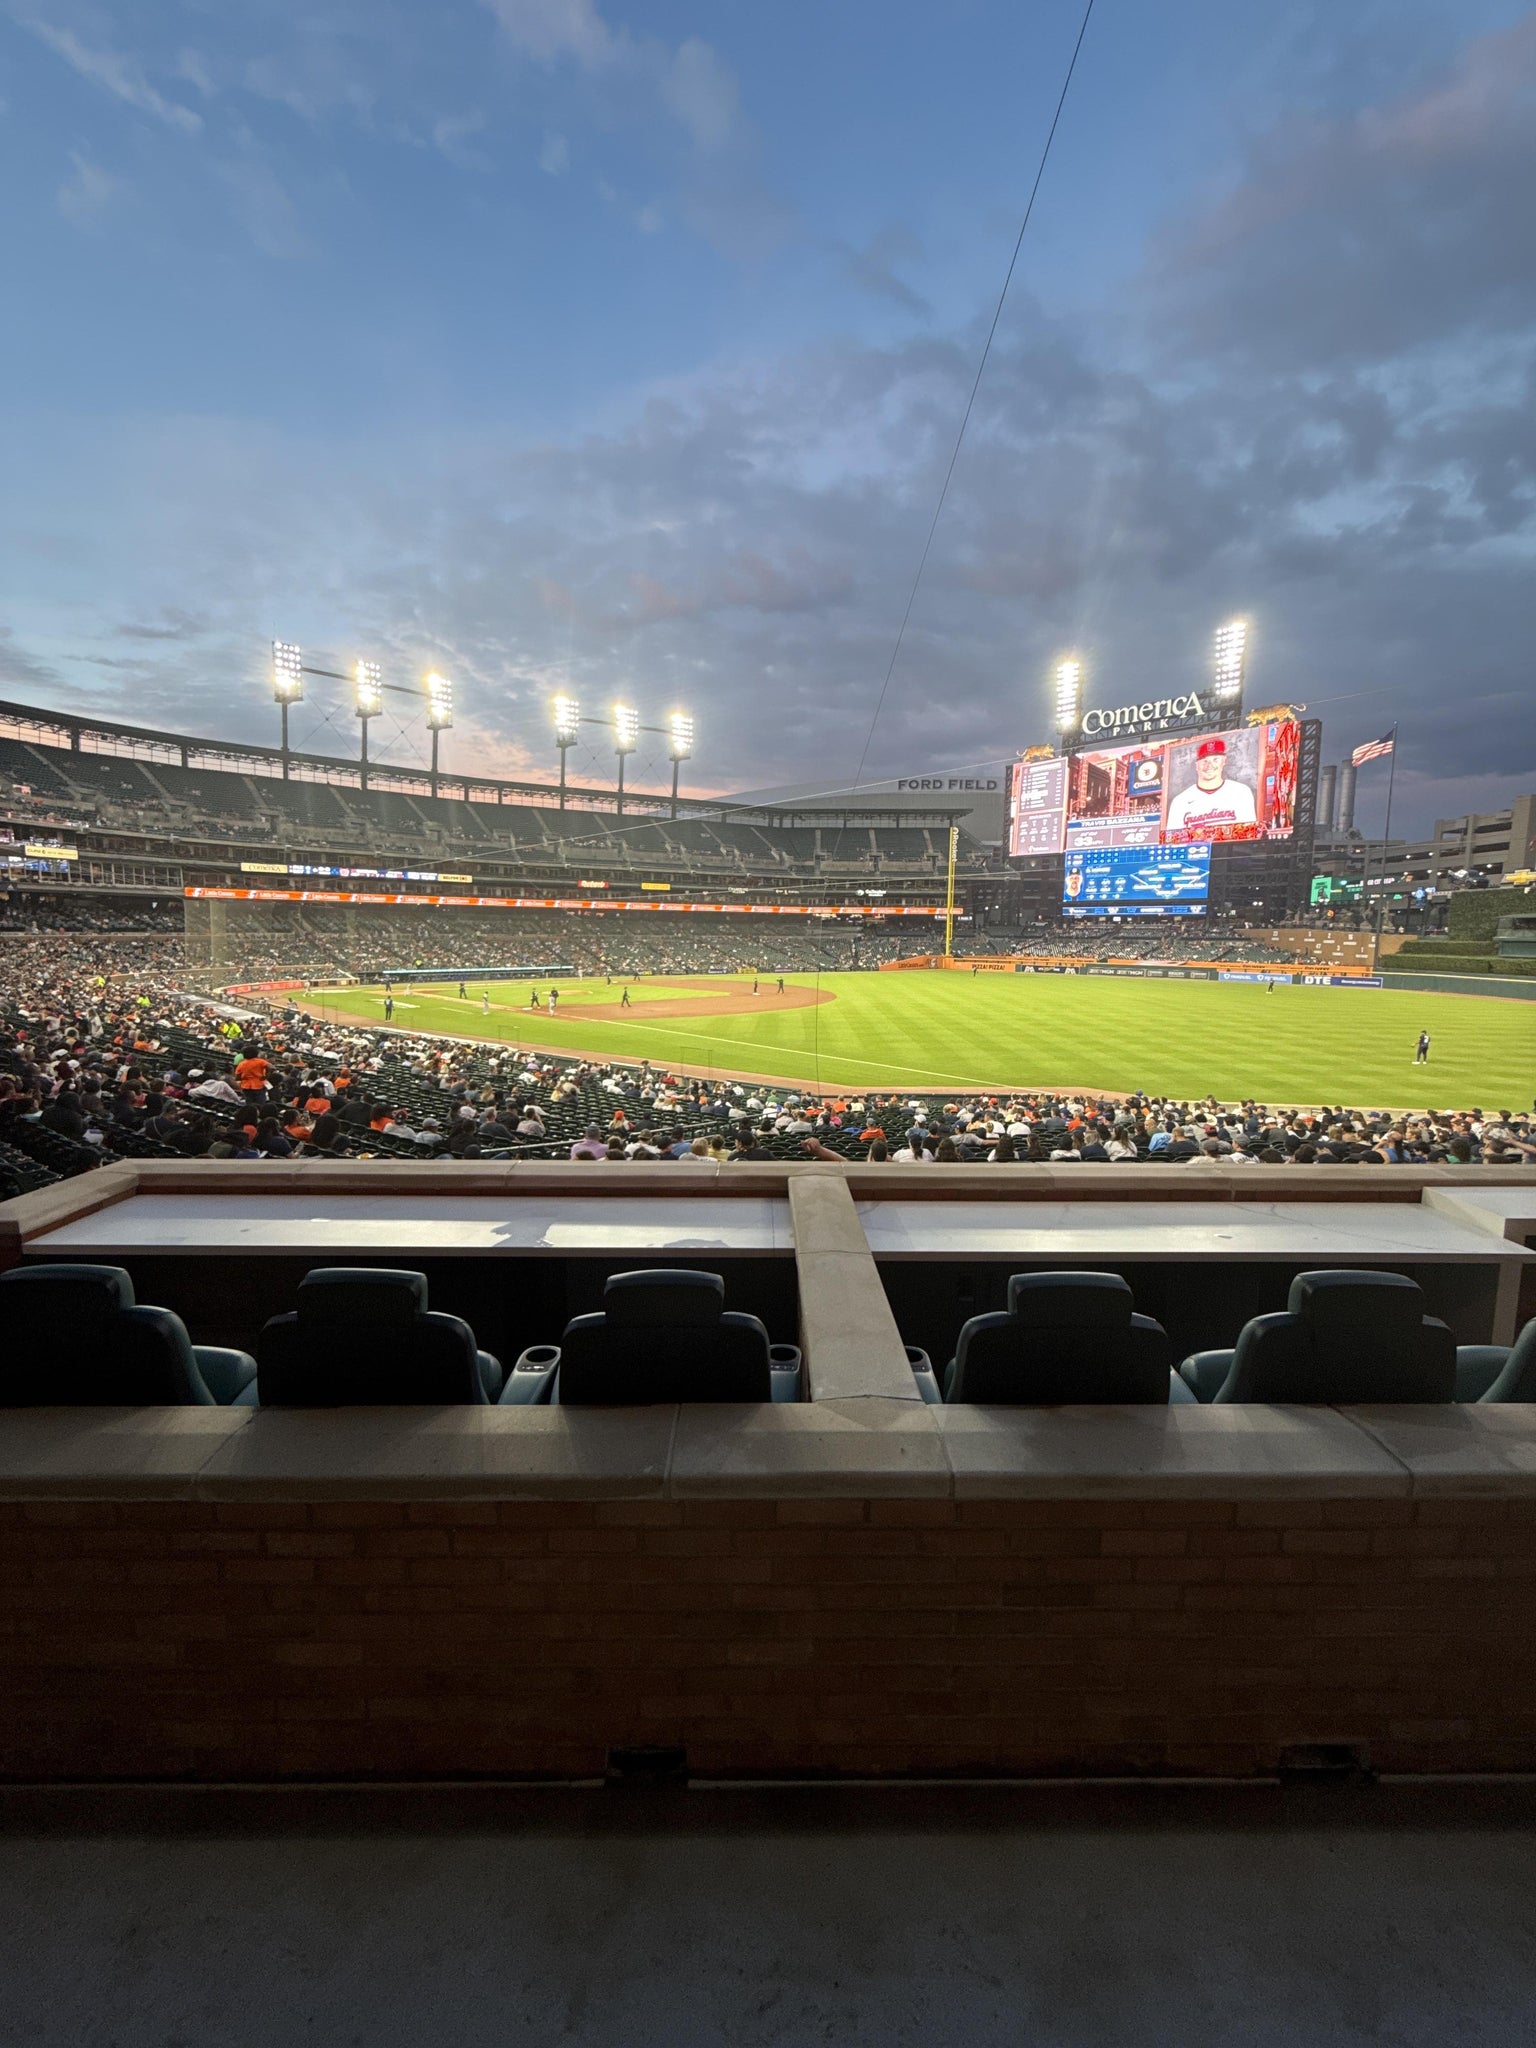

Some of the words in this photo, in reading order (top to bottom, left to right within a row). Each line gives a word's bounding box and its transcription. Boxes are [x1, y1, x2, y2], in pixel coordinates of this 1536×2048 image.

[1112, 719, 1169, 736] PARK
[898, 779, 943, 790] FORD
[948, 779, 997, 790] FIELD
[1183, 808, 1236, 825] Guardians
[1304, 976, 1332, 985] DTE
